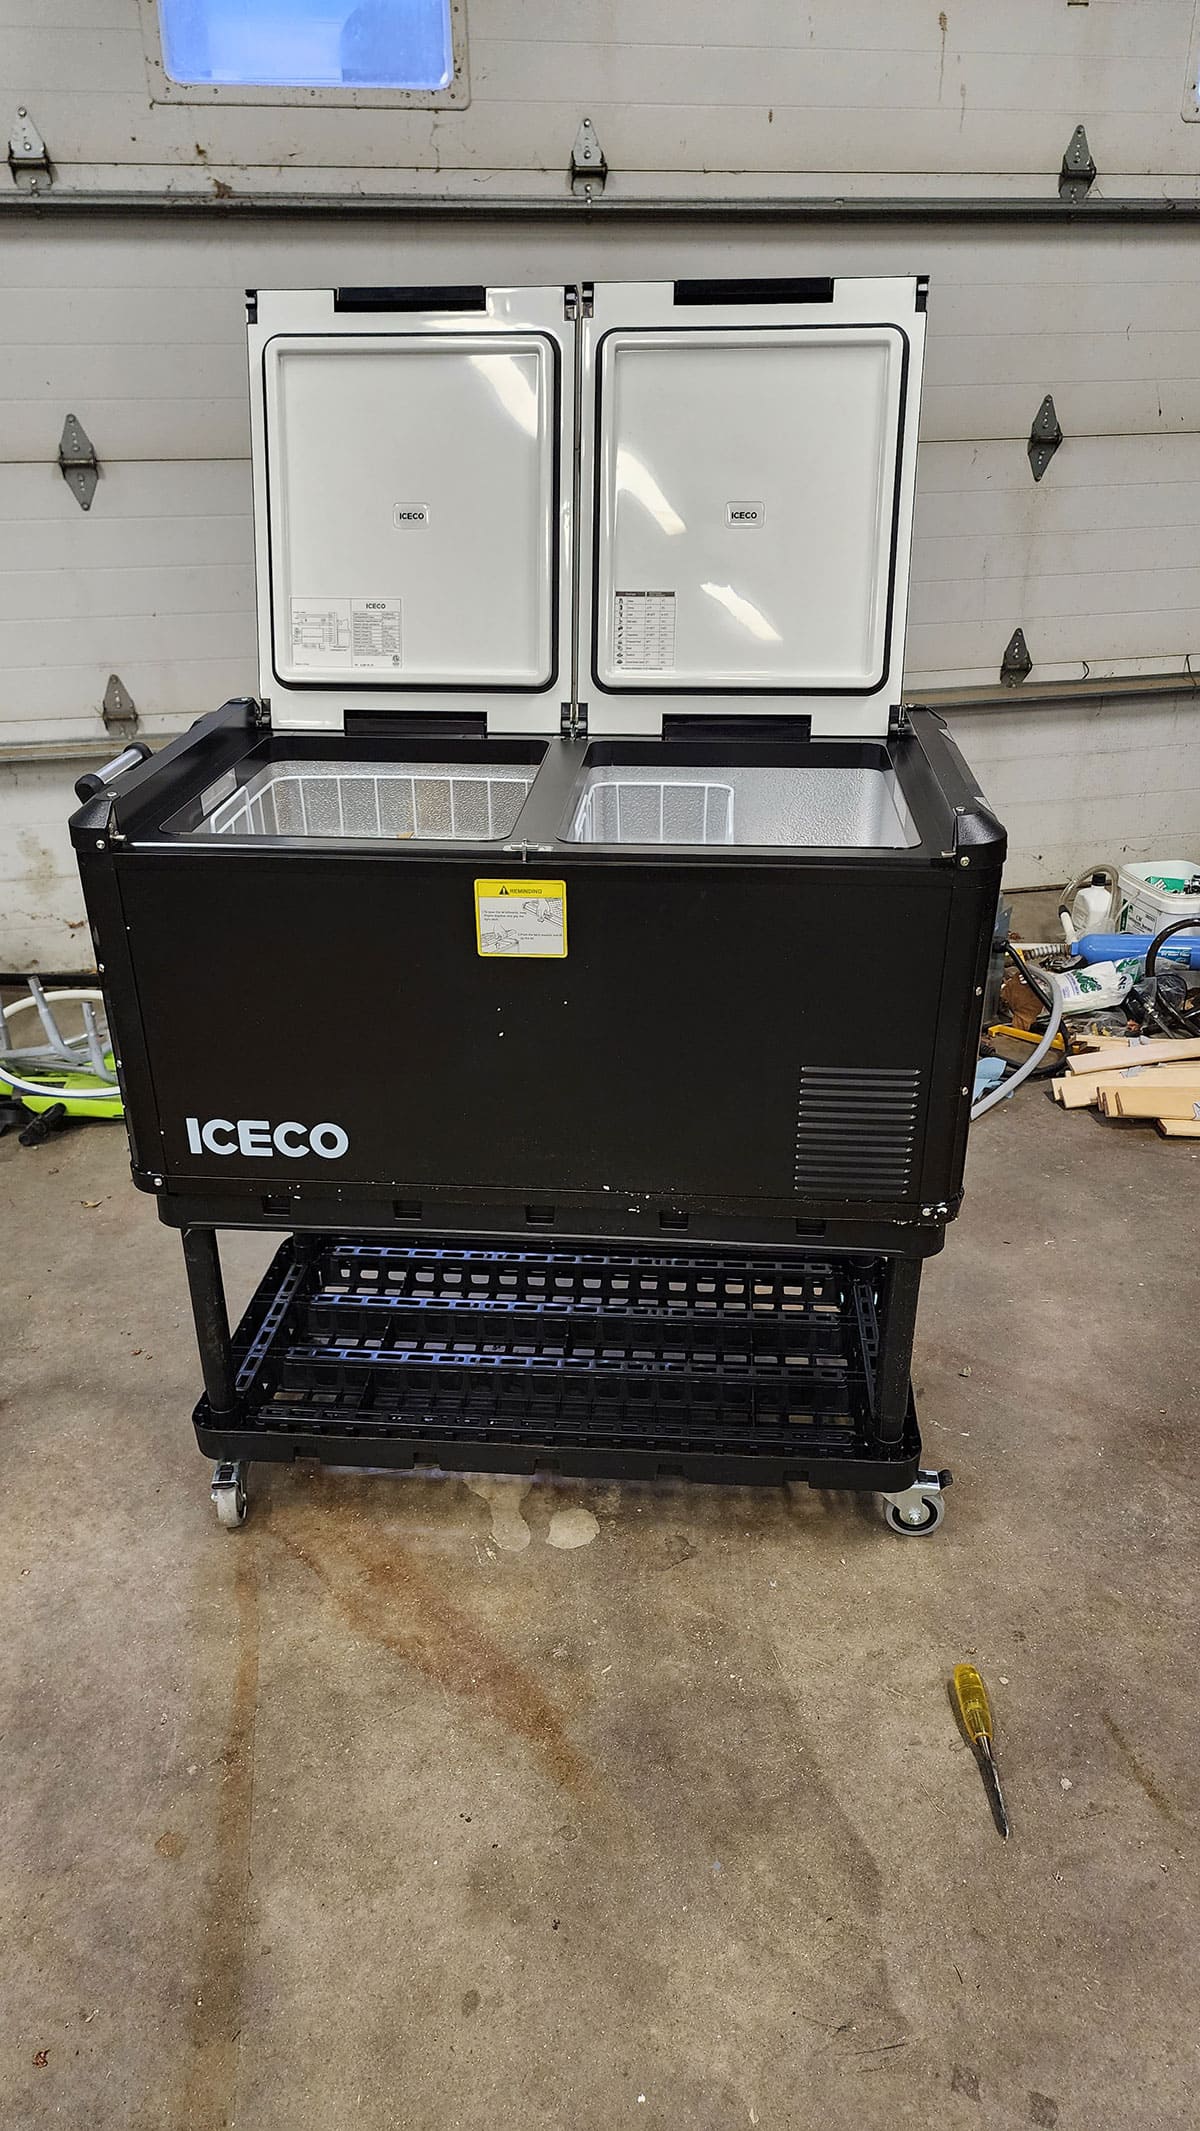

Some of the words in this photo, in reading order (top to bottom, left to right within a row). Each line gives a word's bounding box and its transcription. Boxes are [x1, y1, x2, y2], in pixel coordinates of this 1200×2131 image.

[400, 512, 425, 520] ICECO
[731, 511, 757, 519] ICECO
[185, 1117, 349, 1159] ICECO
